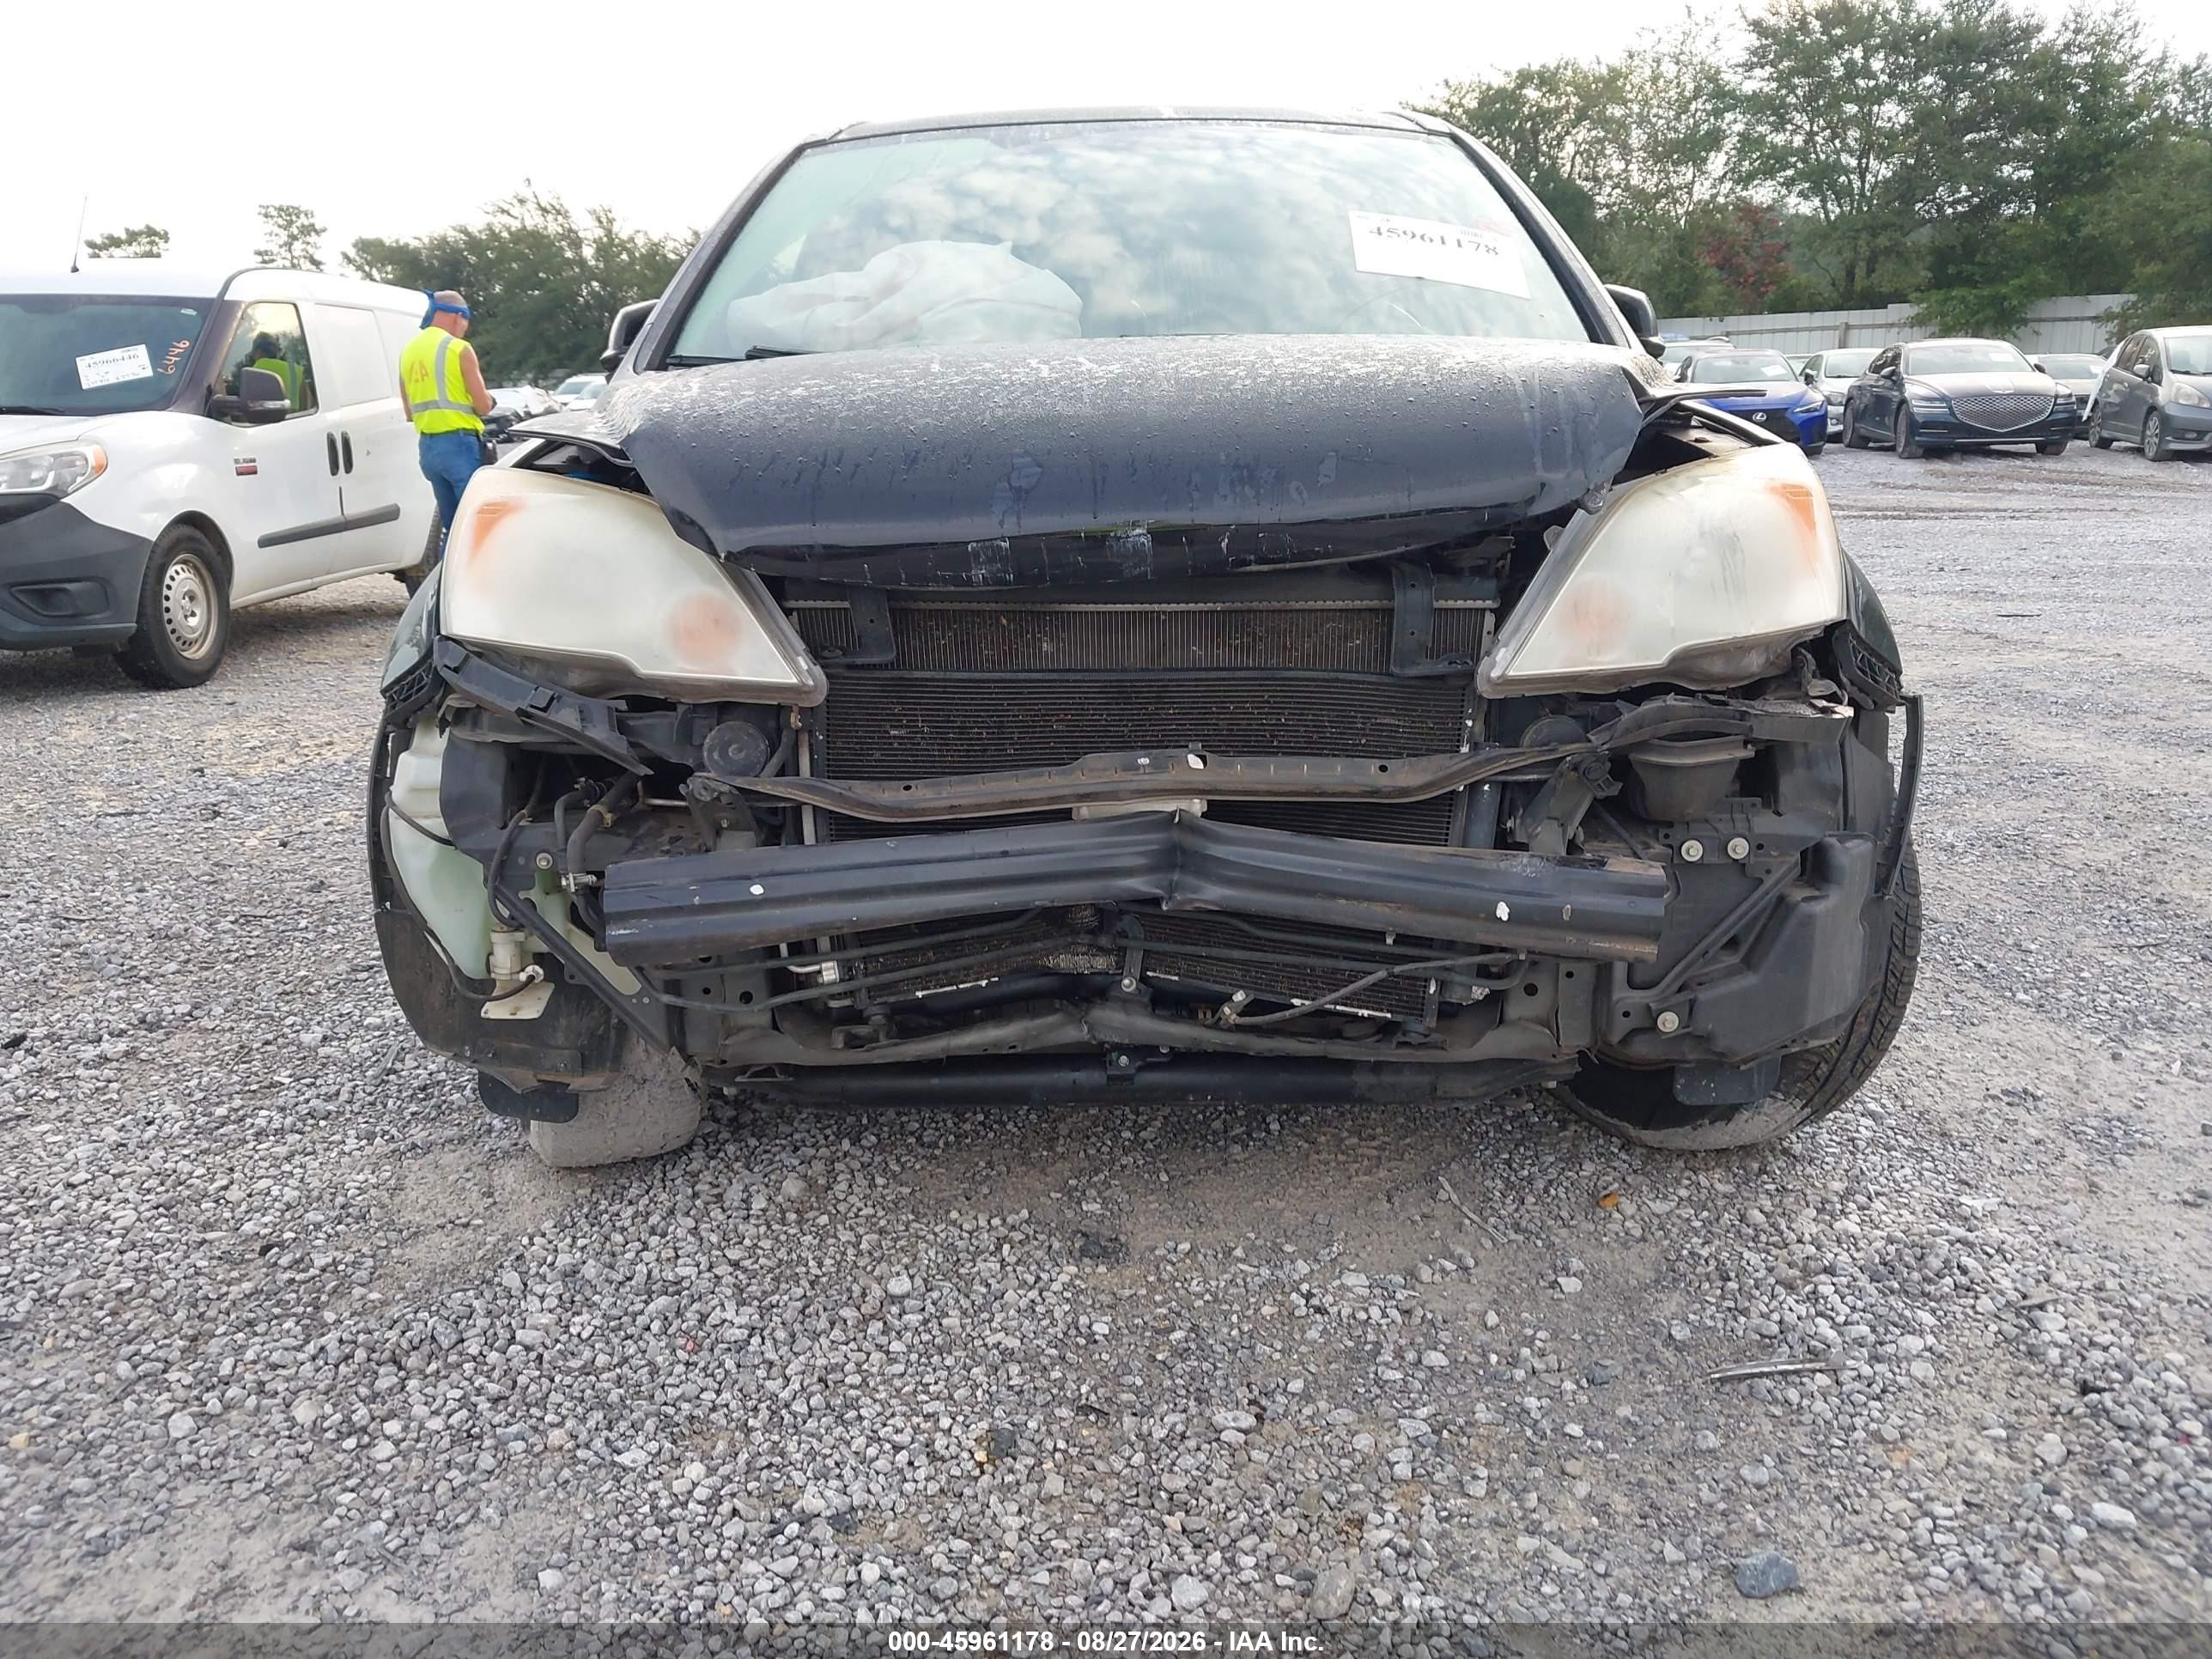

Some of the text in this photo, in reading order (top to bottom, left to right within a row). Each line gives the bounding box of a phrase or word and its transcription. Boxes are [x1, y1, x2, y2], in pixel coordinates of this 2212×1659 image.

[1369, 226, 1500, 256] 45961178
[86, 354, 140, 369] 45966446
[157, 340, 191, 375] 6446
